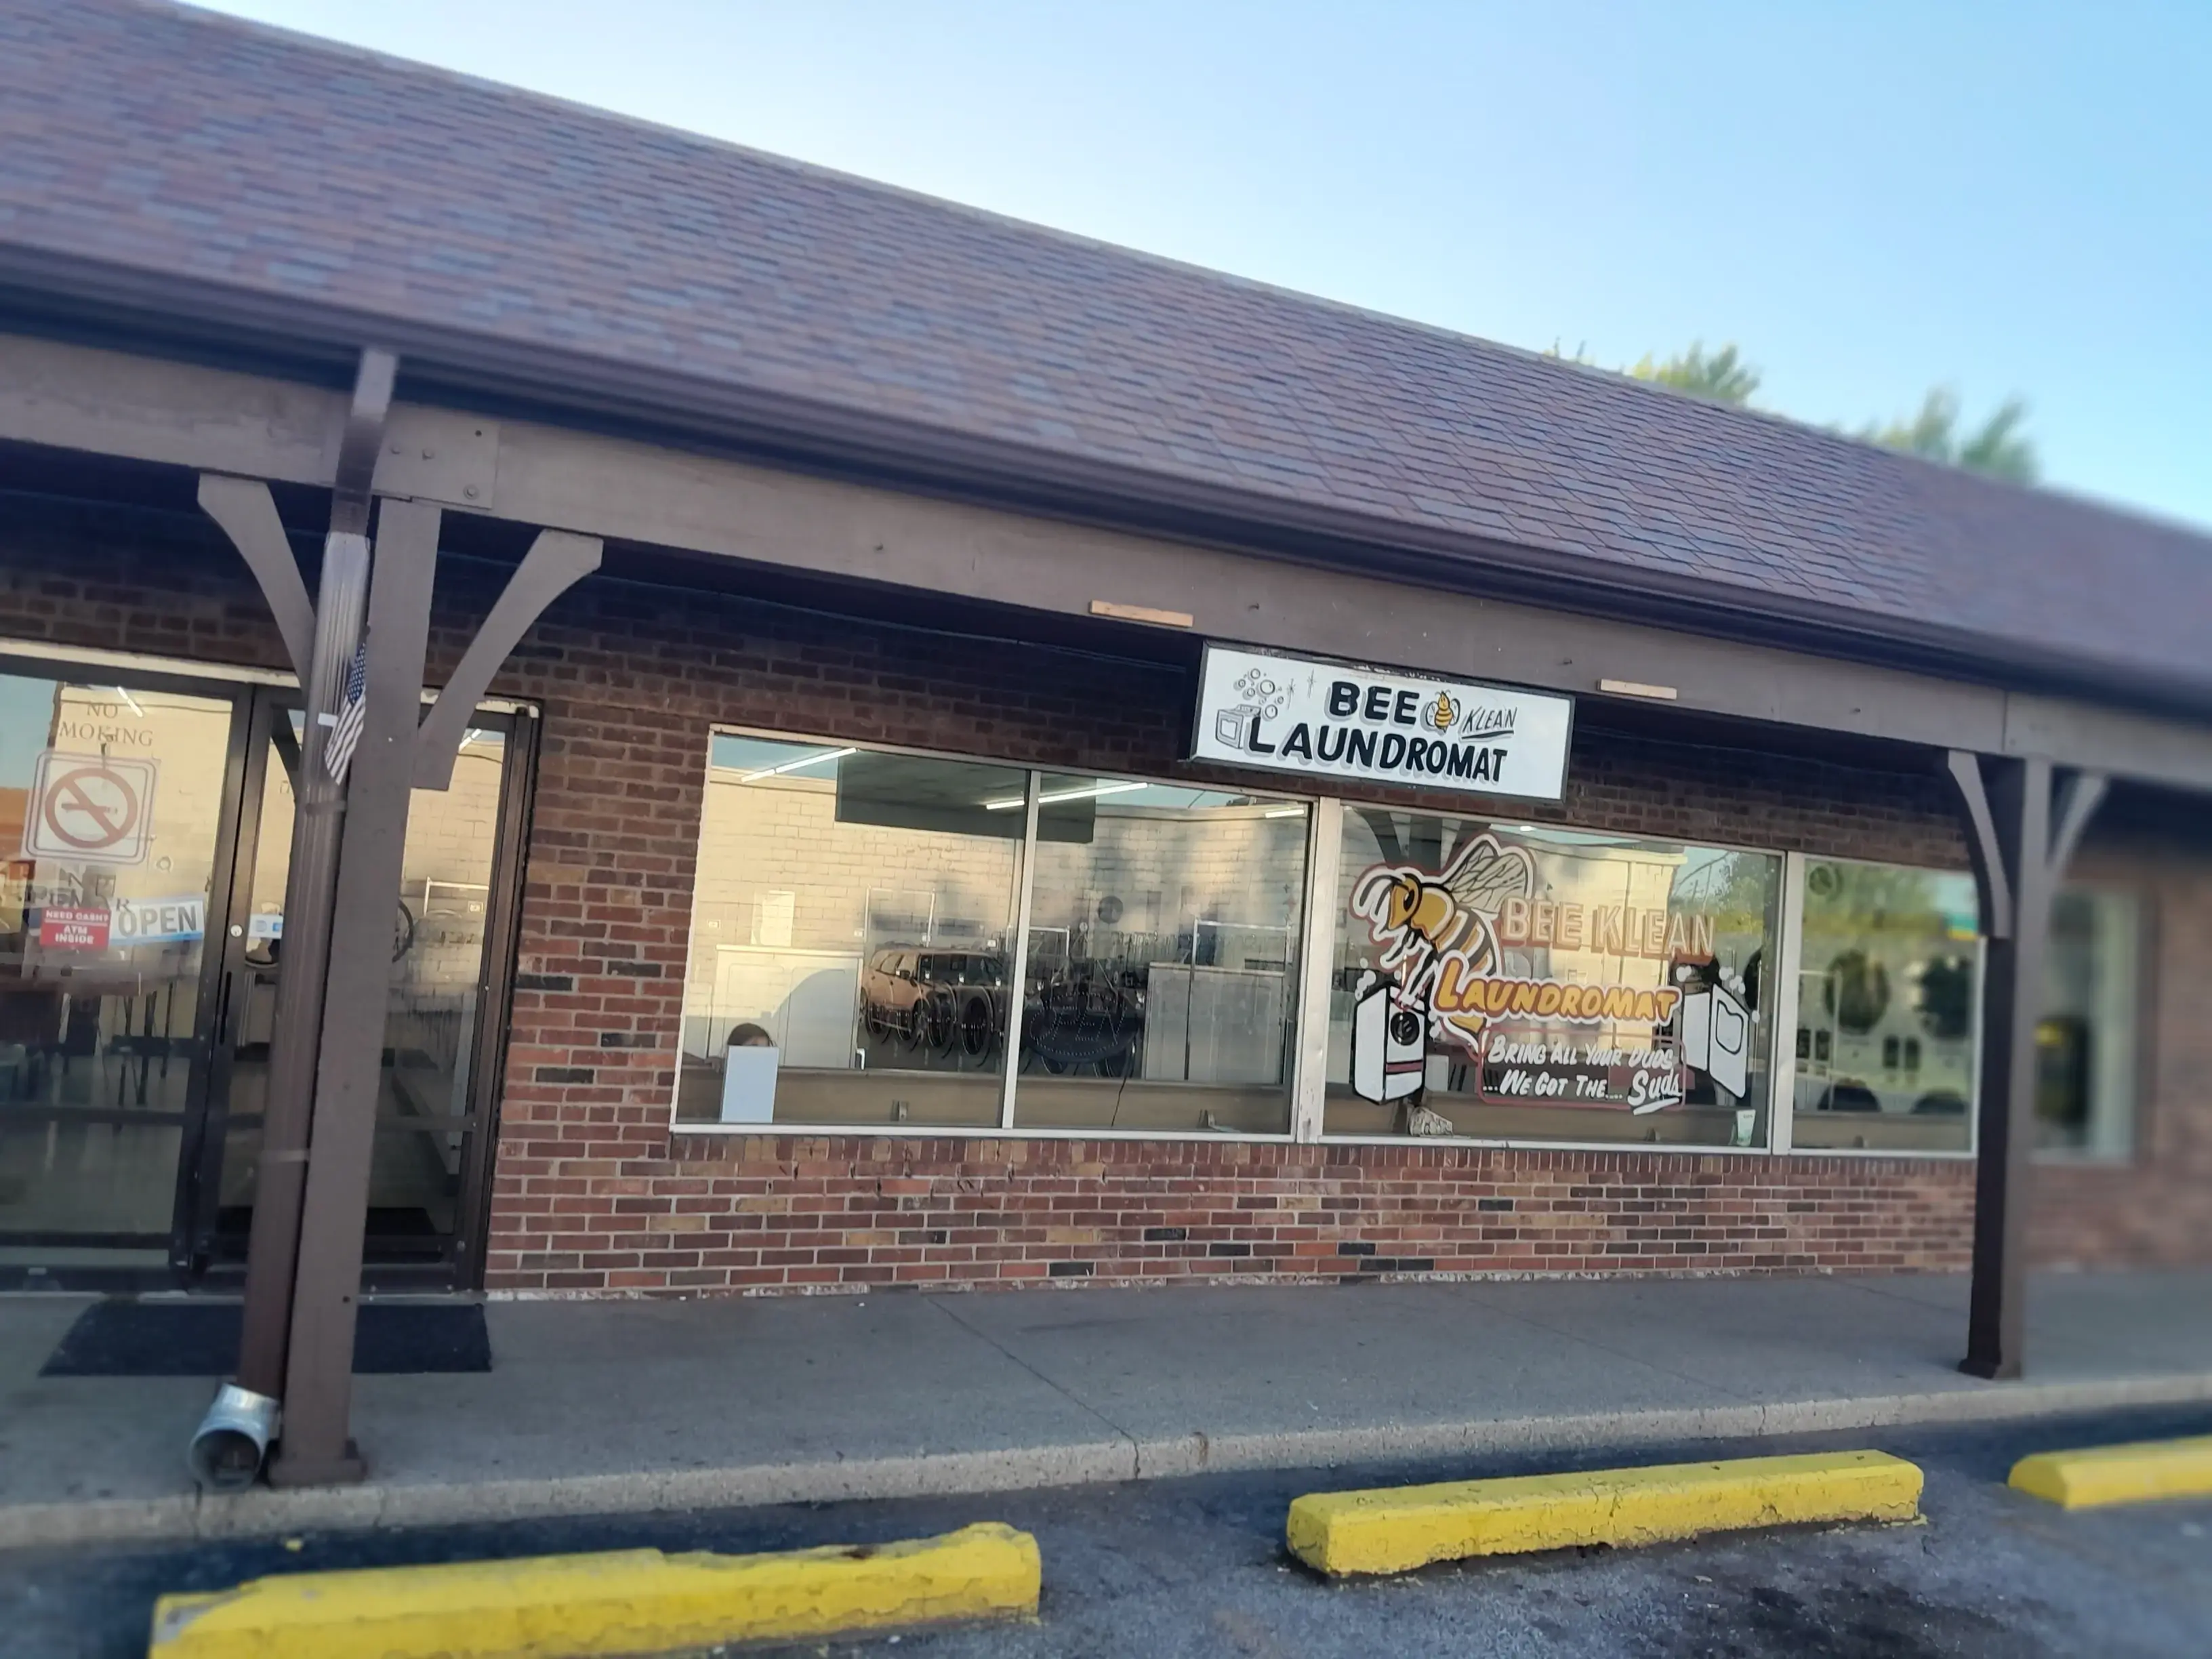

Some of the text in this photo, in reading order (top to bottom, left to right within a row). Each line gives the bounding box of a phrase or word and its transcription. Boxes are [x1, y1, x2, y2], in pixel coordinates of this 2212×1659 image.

[1325, 680, 1519, 734] BEE KLEAN
[1247, 716, 1509, 783] LAUNDROMAT
[45, 909, 73, 920] NEED
[64, 925, 88, 935] ATM
[118, 905, 198, 937] OPEN
[1500, 897, 1715, 964] BEE KLEAN
[55, 933, 94, 945] INSIDE
[1433, 957, 1679, 1021] LAUNDROMAT
[1488, 1034, 1547, 1065] BRING
[1550, 1042, 1578, 1066] ALL
[1584, 1042, 1622, 1067] YOUR
[1534, 1071, 1569, 1097] GOT
